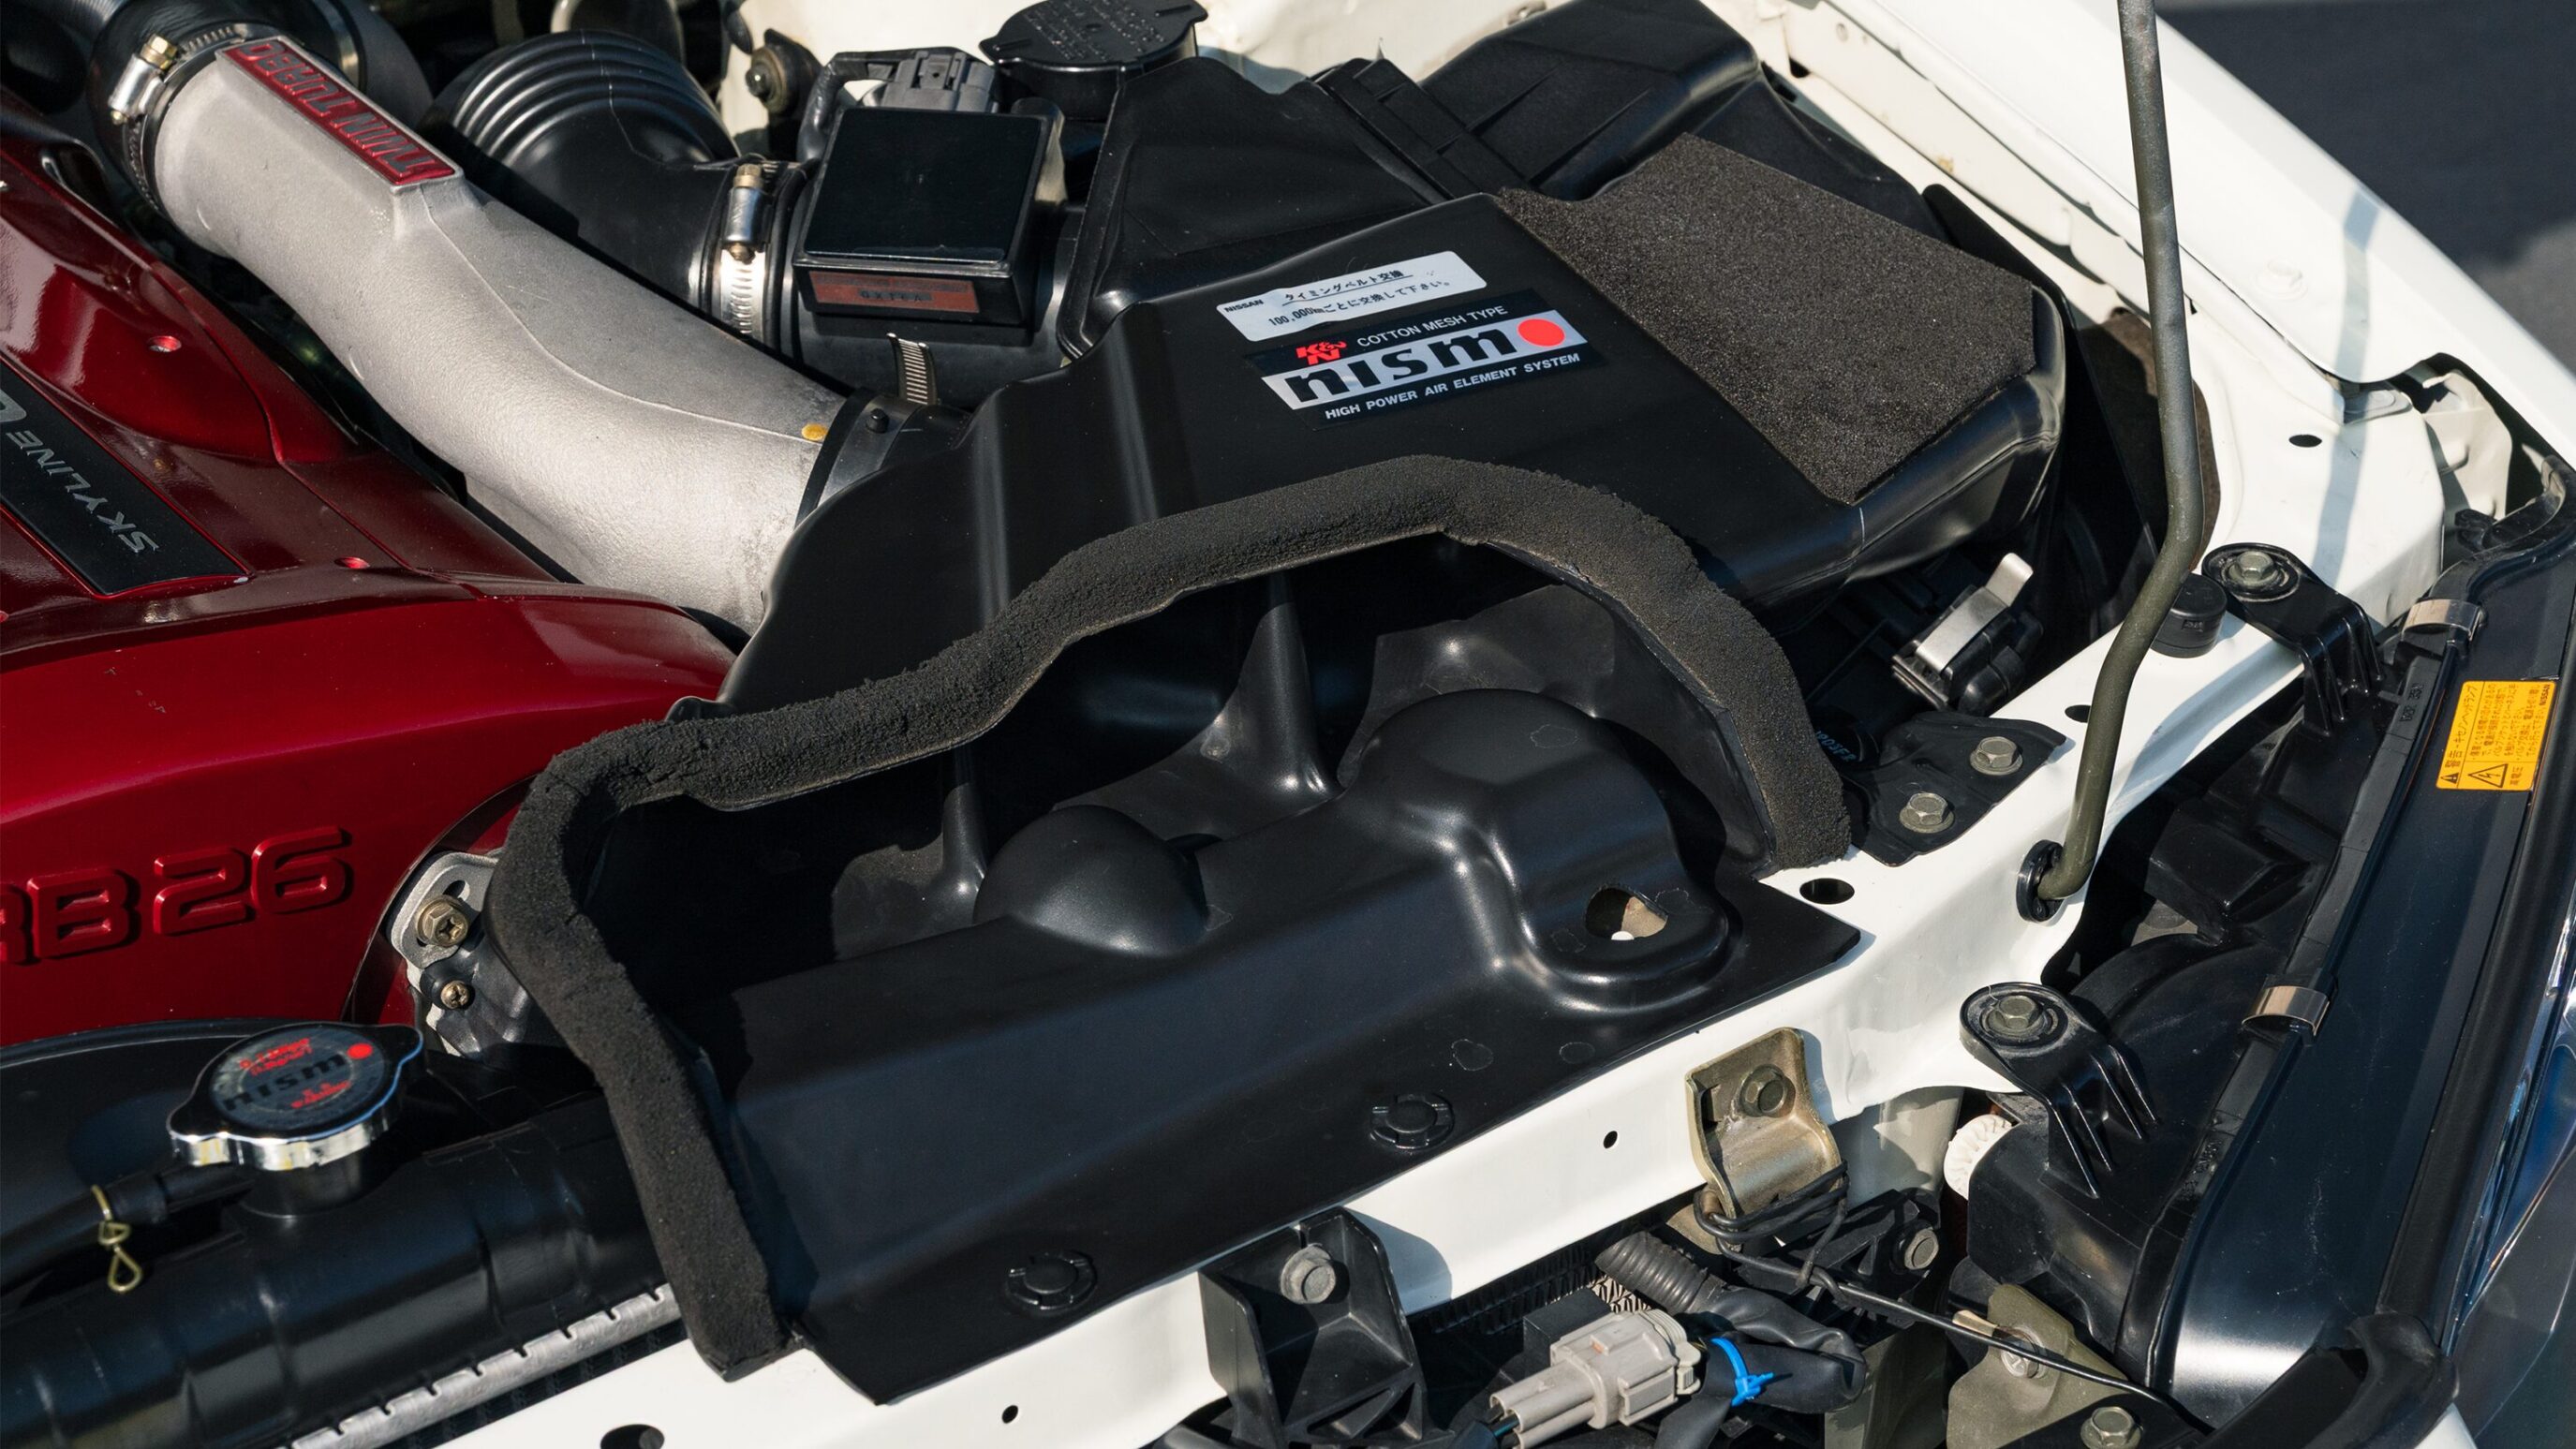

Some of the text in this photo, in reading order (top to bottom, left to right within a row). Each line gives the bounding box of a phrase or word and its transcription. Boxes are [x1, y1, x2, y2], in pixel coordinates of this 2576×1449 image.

[236, 40, 436, 178] TWIN TURBO
[1224, 299, 1265, 313] NISSAN
[1356, 304, 1509, 347] COTTON MESH TYPE
[1325, 352, 1581, 421] HIGH POWER AIR ELEMENT SYSTEM
[6, 430, 160, 554] SKYLINE
